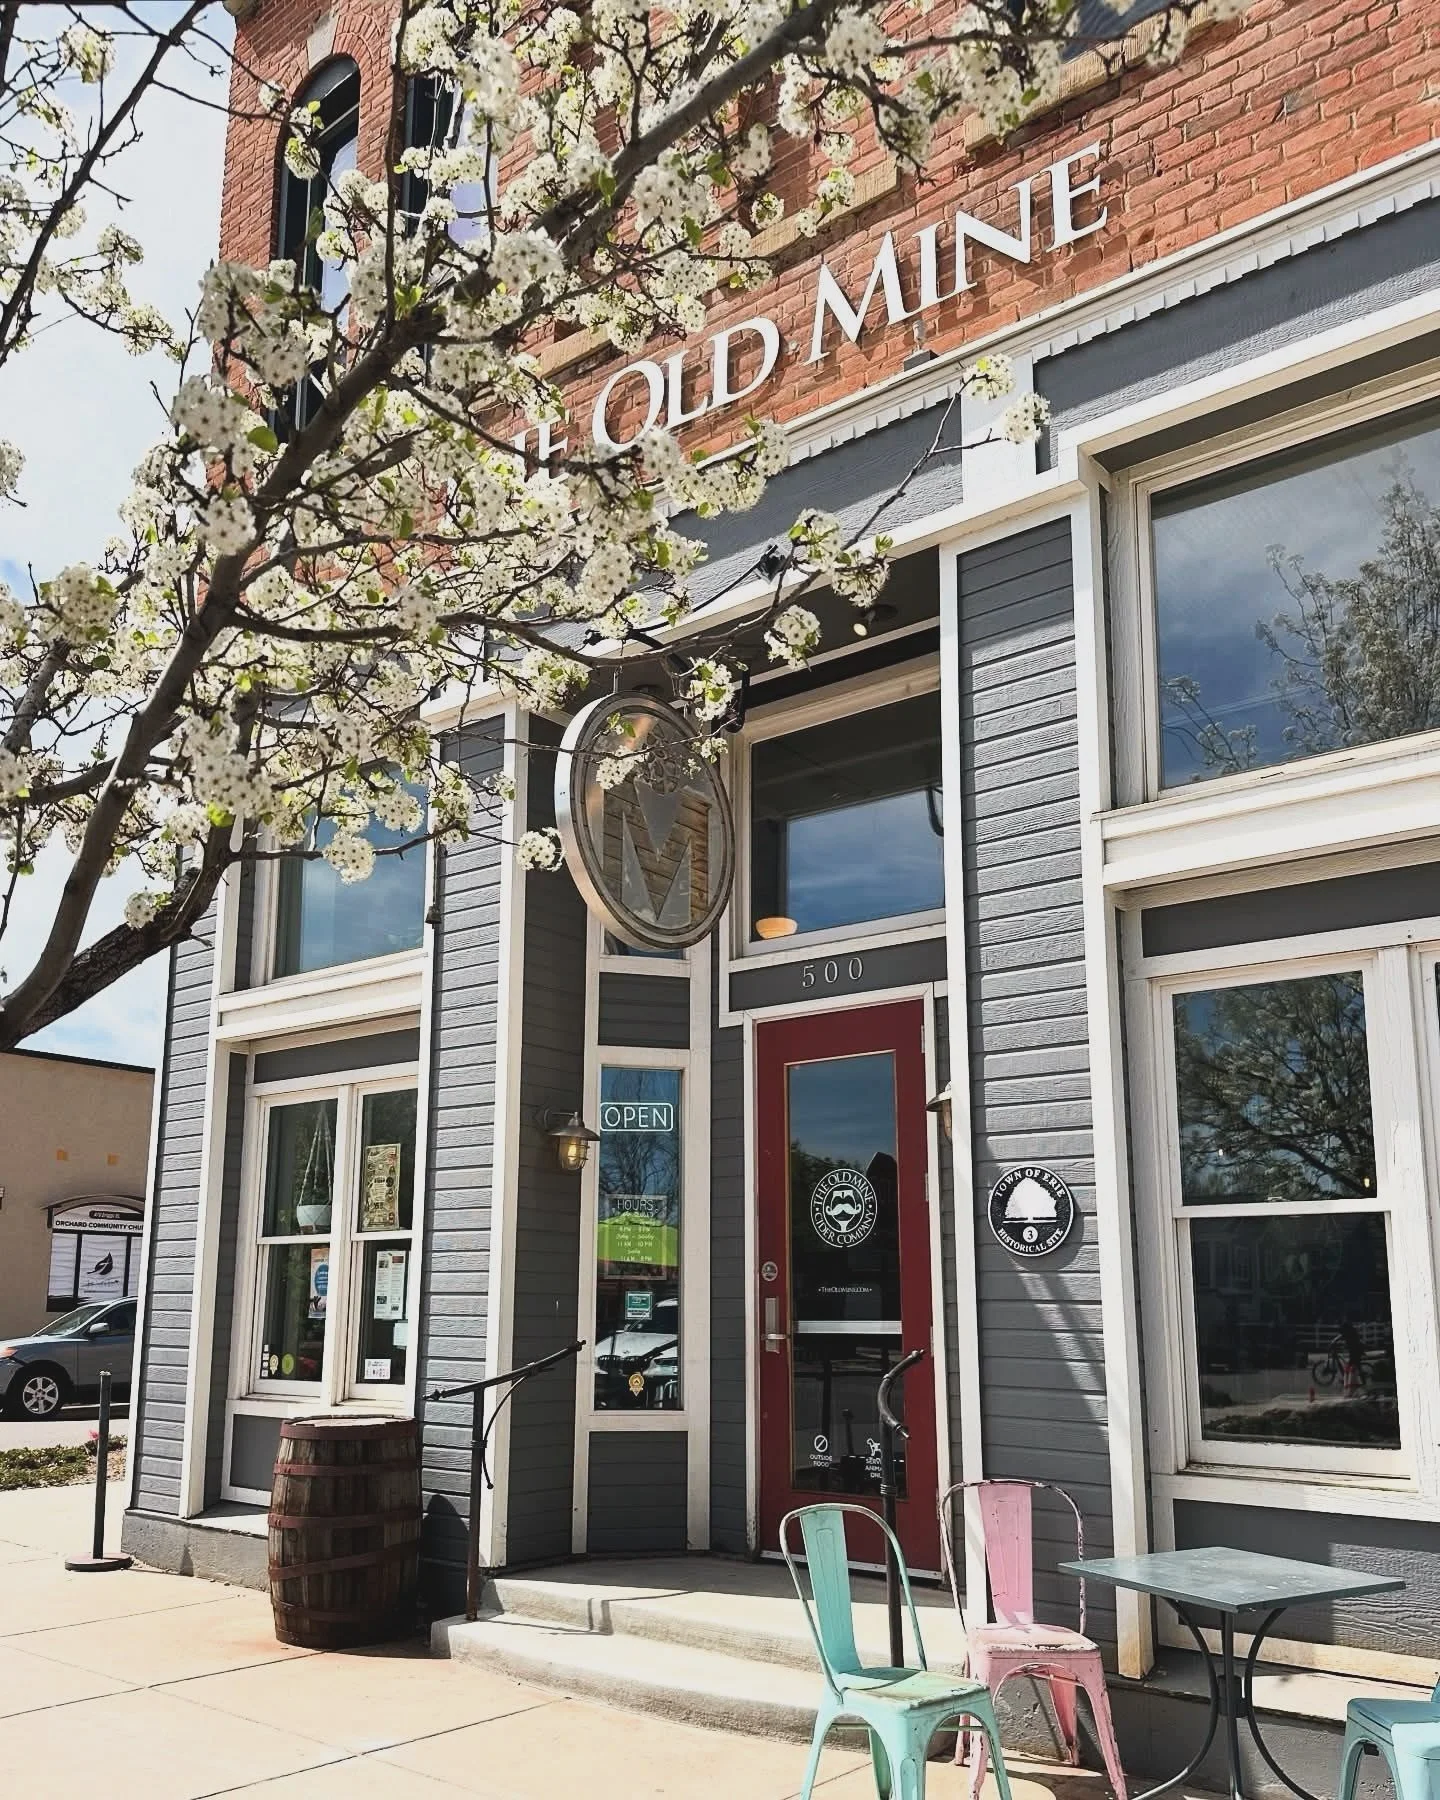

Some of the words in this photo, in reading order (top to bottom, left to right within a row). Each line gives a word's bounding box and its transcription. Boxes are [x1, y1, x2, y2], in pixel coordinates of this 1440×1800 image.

[592, 316, 781, 452] OLD
[804, 143, 1109, 365] MINE
[602, 774, 713, 925] M
[801, 956, 864, 988] 500
[604, 1106, 668, 1129] OPEN
[813, 1180, 831, 1207] THE
[828, 1171, 852, 1185] OLD
[850, 1175, 875, 1205] MINE
[994, 1170, 1023, 1197] TOWN
[1025, 1168, 1041, 1178] OF
[1042, 1173, 1066, 1198] ERIE
[617, 1199, 654, 1211] HOURS
[55, 1220, 88, 1228] ORCHARD
[88, 1222, 127, 1230] COMMUNITY
[814, 1211, 836, 1242] CIDER
[836, 1208, 875, 1244] COMPANY
[1026, 1230, 1034, 1240] 3
[997, 1227, 1047, 1253] HISTORICAL
[1045, 1227, 1064, 1247] SITE
[809, 1454, 833, 1462] OUTSIDE
